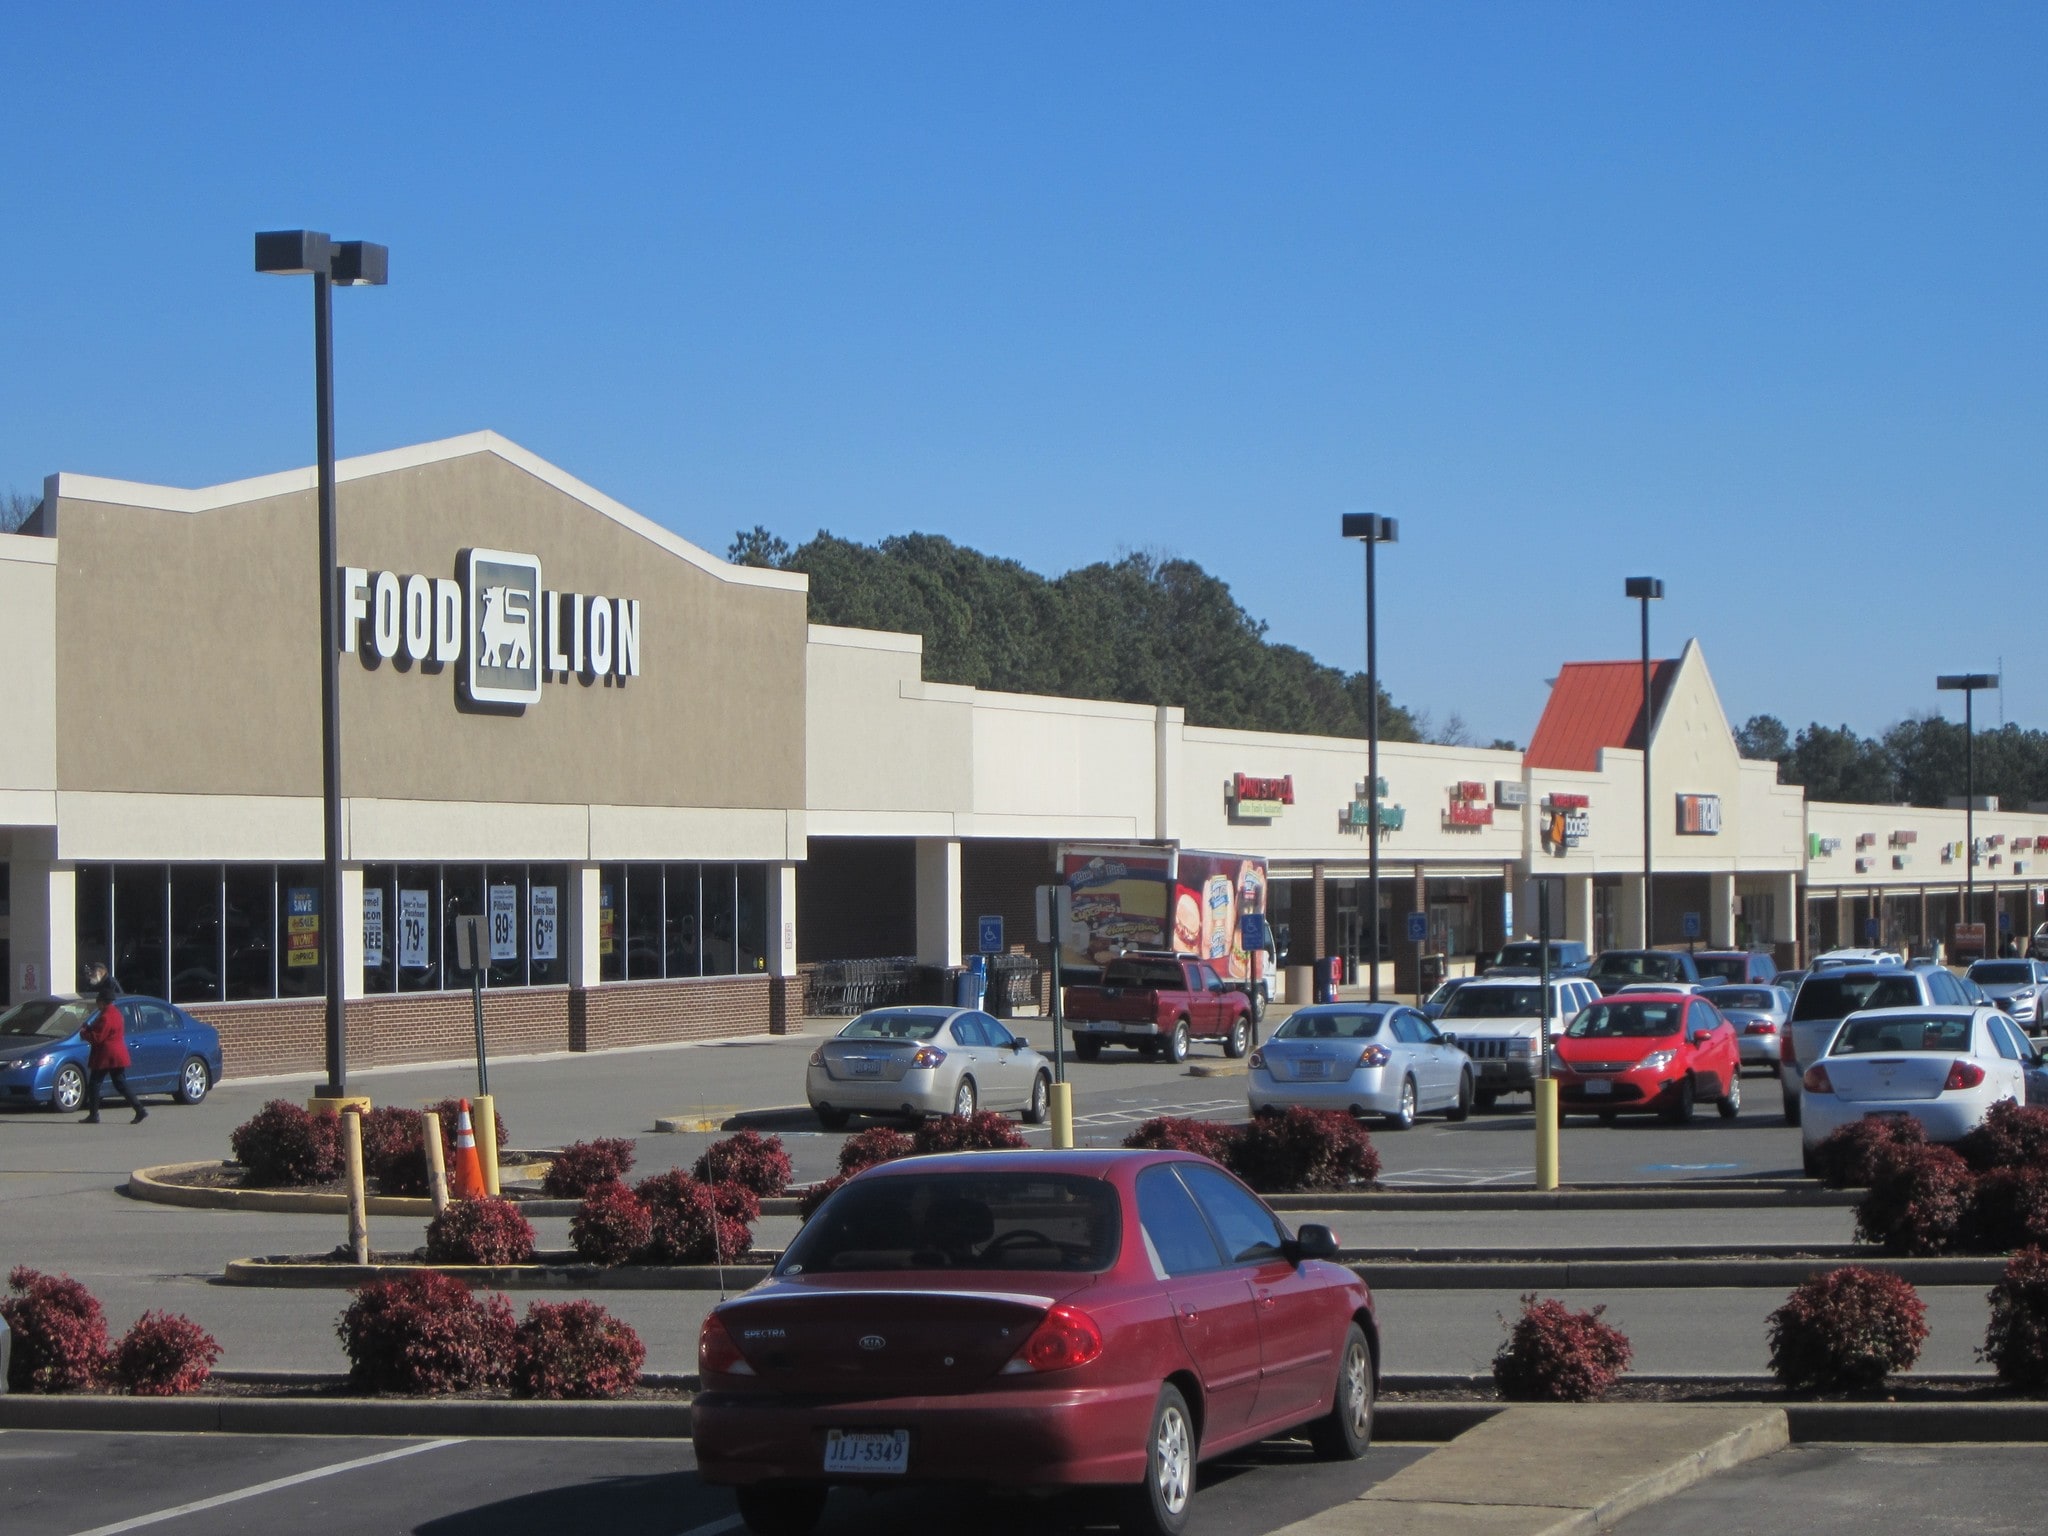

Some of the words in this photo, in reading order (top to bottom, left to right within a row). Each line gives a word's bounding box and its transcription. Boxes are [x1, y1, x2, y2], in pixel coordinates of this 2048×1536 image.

[343, 566, 462, 662] FOOD
[548, 590, 640, 676] LION
[294, 900, 312, 912] SAVE
[1072, 904, 1115, 923] Cupcakes
[1105, 923, 1139, 936] Honey
[1139, 923, 1160, 935] Buns
[363, 932, 381, 949] REE
[744, 1329, 787, 1340] SPECTRA
[831, 1442, 903, 1462] JLJ-5349
